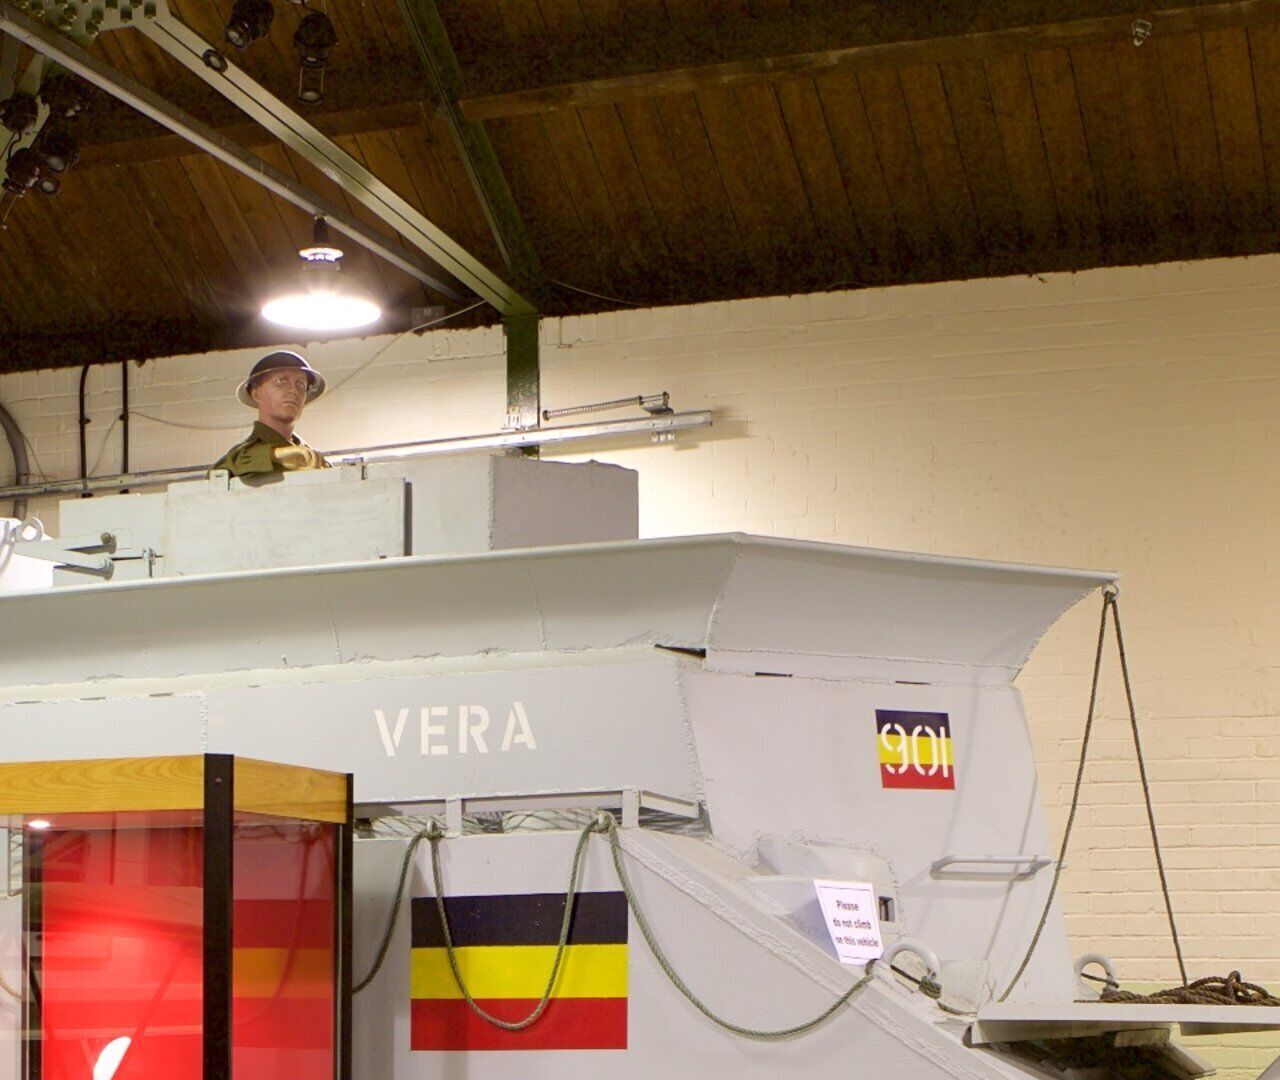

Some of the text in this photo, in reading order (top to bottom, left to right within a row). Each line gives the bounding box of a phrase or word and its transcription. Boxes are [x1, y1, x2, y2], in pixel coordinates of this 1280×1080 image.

[373, 701, 537, 757] VERA
[880, 722, 949, 778] 901
[836, 900, 859, 911] Please
